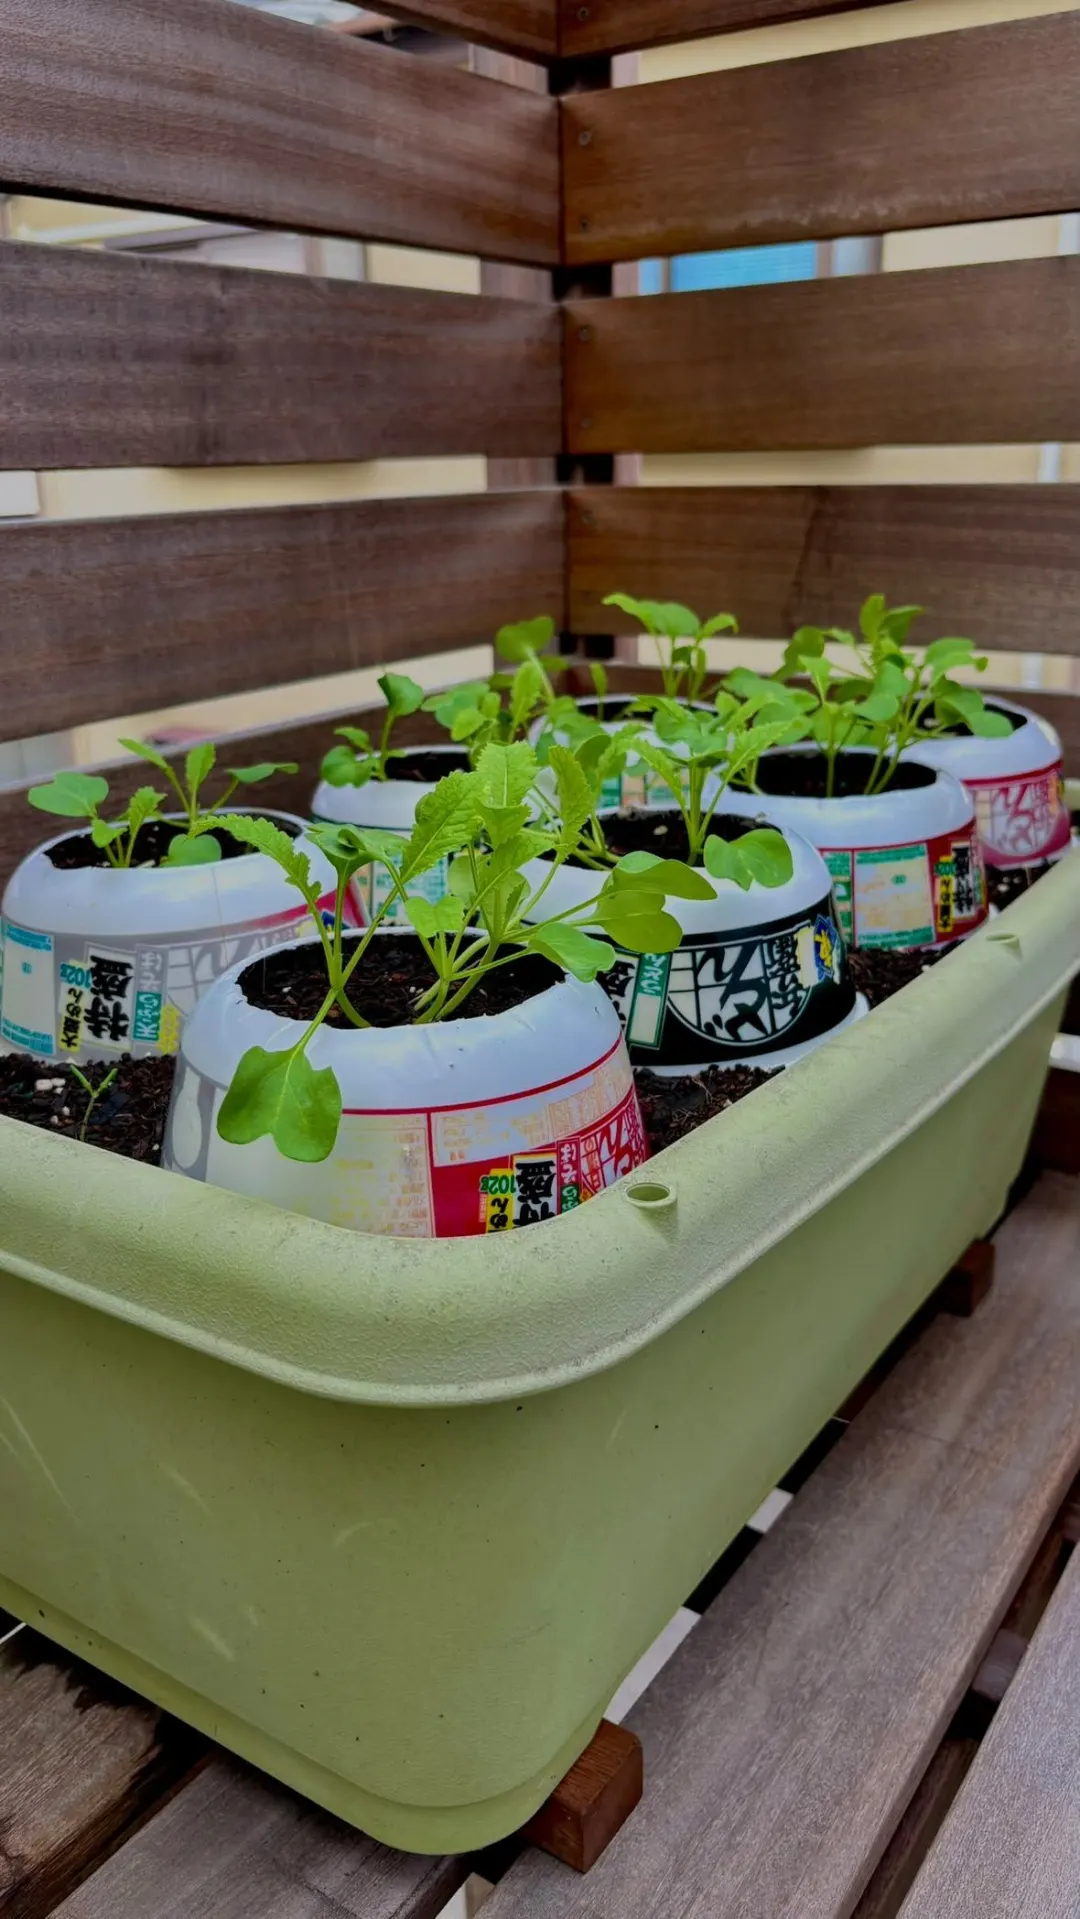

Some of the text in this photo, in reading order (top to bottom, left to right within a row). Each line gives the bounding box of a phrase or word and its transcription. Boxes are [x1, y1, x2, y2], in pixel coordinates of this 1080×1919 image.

[61, 988, 83, 1048] 大盛めん
[84, 955, 133, 1041] 特盛
[697, 942, 768, 1040] どん
